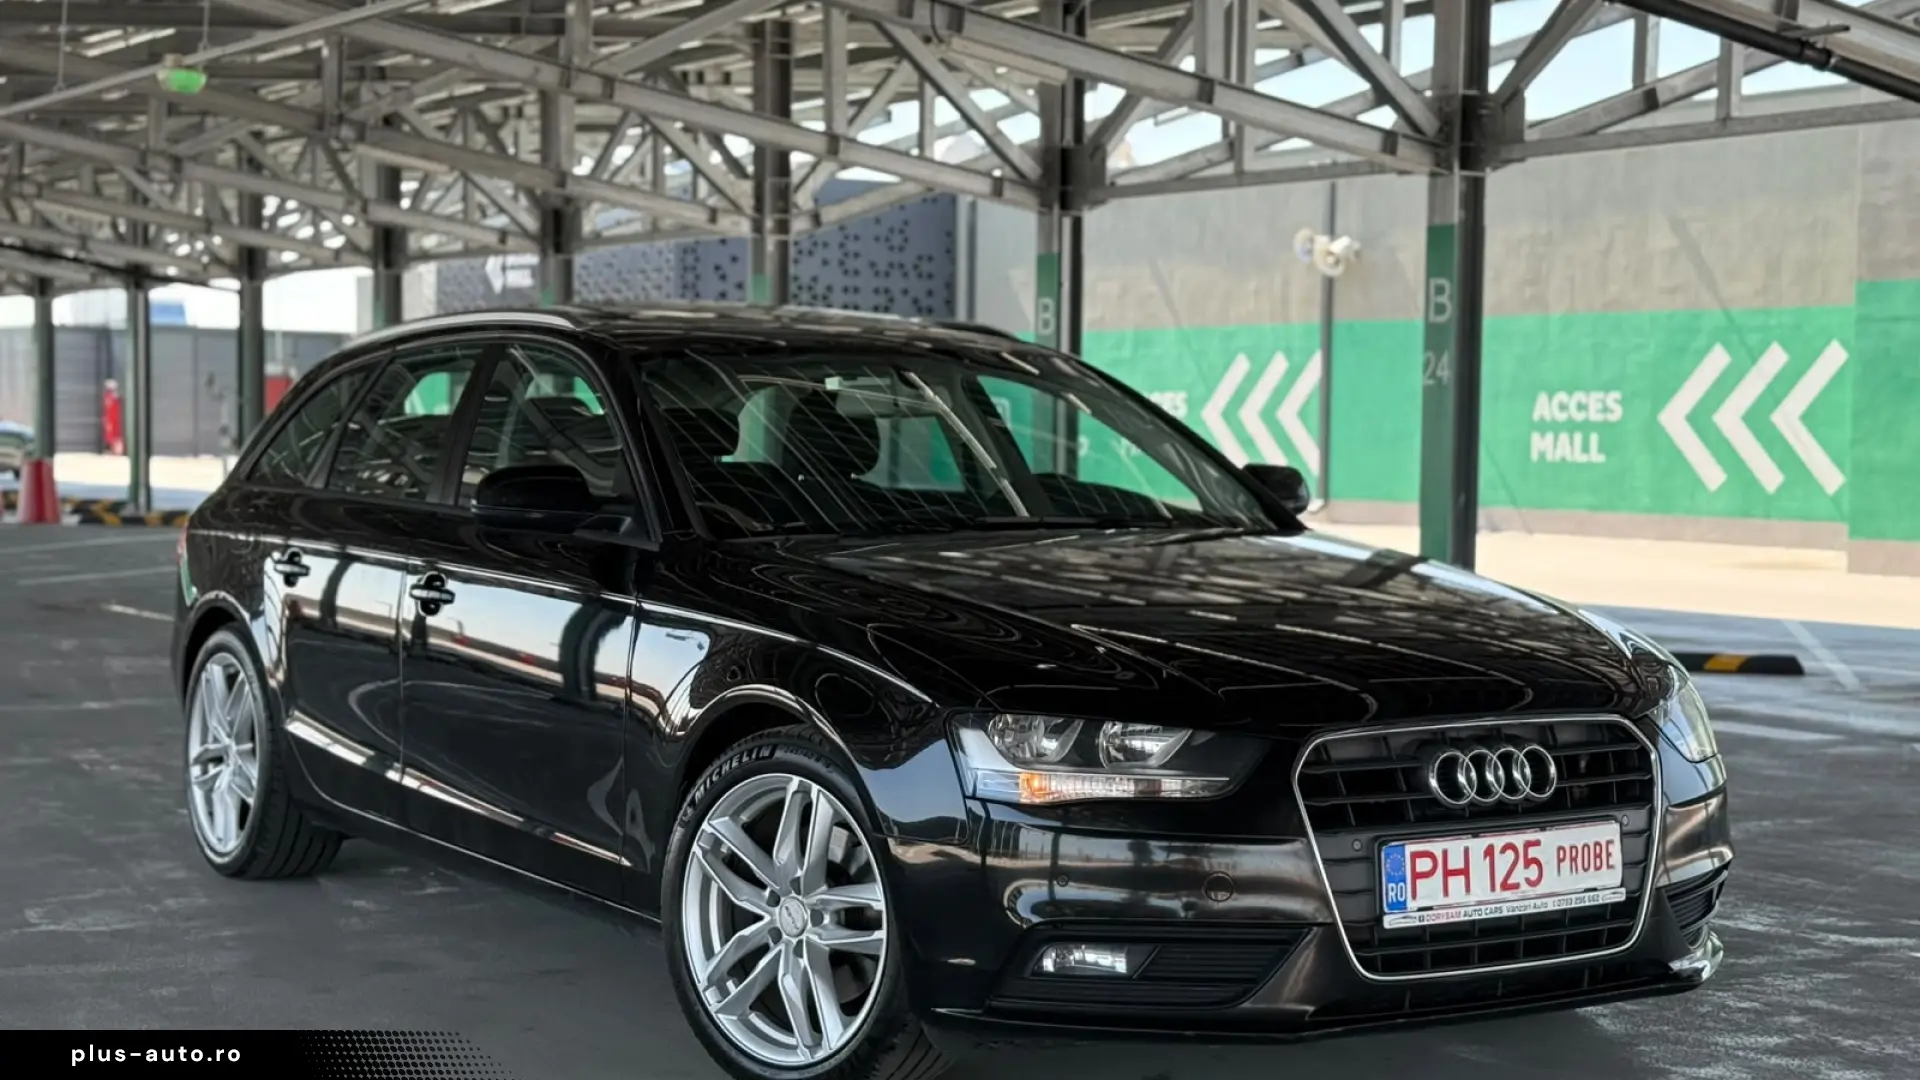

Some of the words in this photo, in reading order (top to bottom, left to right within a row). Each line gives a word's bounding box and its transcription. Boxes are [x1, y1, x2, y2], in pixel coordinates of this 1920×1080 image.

[1038, 298, 1056, 337] B
[1428, 277, 1452, 323] B
[1423, 350, 1449, 386] 24
[1533, 391, 1623, 423] ACCES
[1531, 432, 1606, 463] MALL
[694, 745, 773, 803] MICHELIN
[1410, 846, 1471, 900] PH
[1483, 839, 1543, 893] 125
[1556, 840, 1615, 877] PROBE
[1388, 882, 1406, 904] RO
[1463, 908, 1483, 918] AUTO
[1484, 905, 1503, 915] CARS
